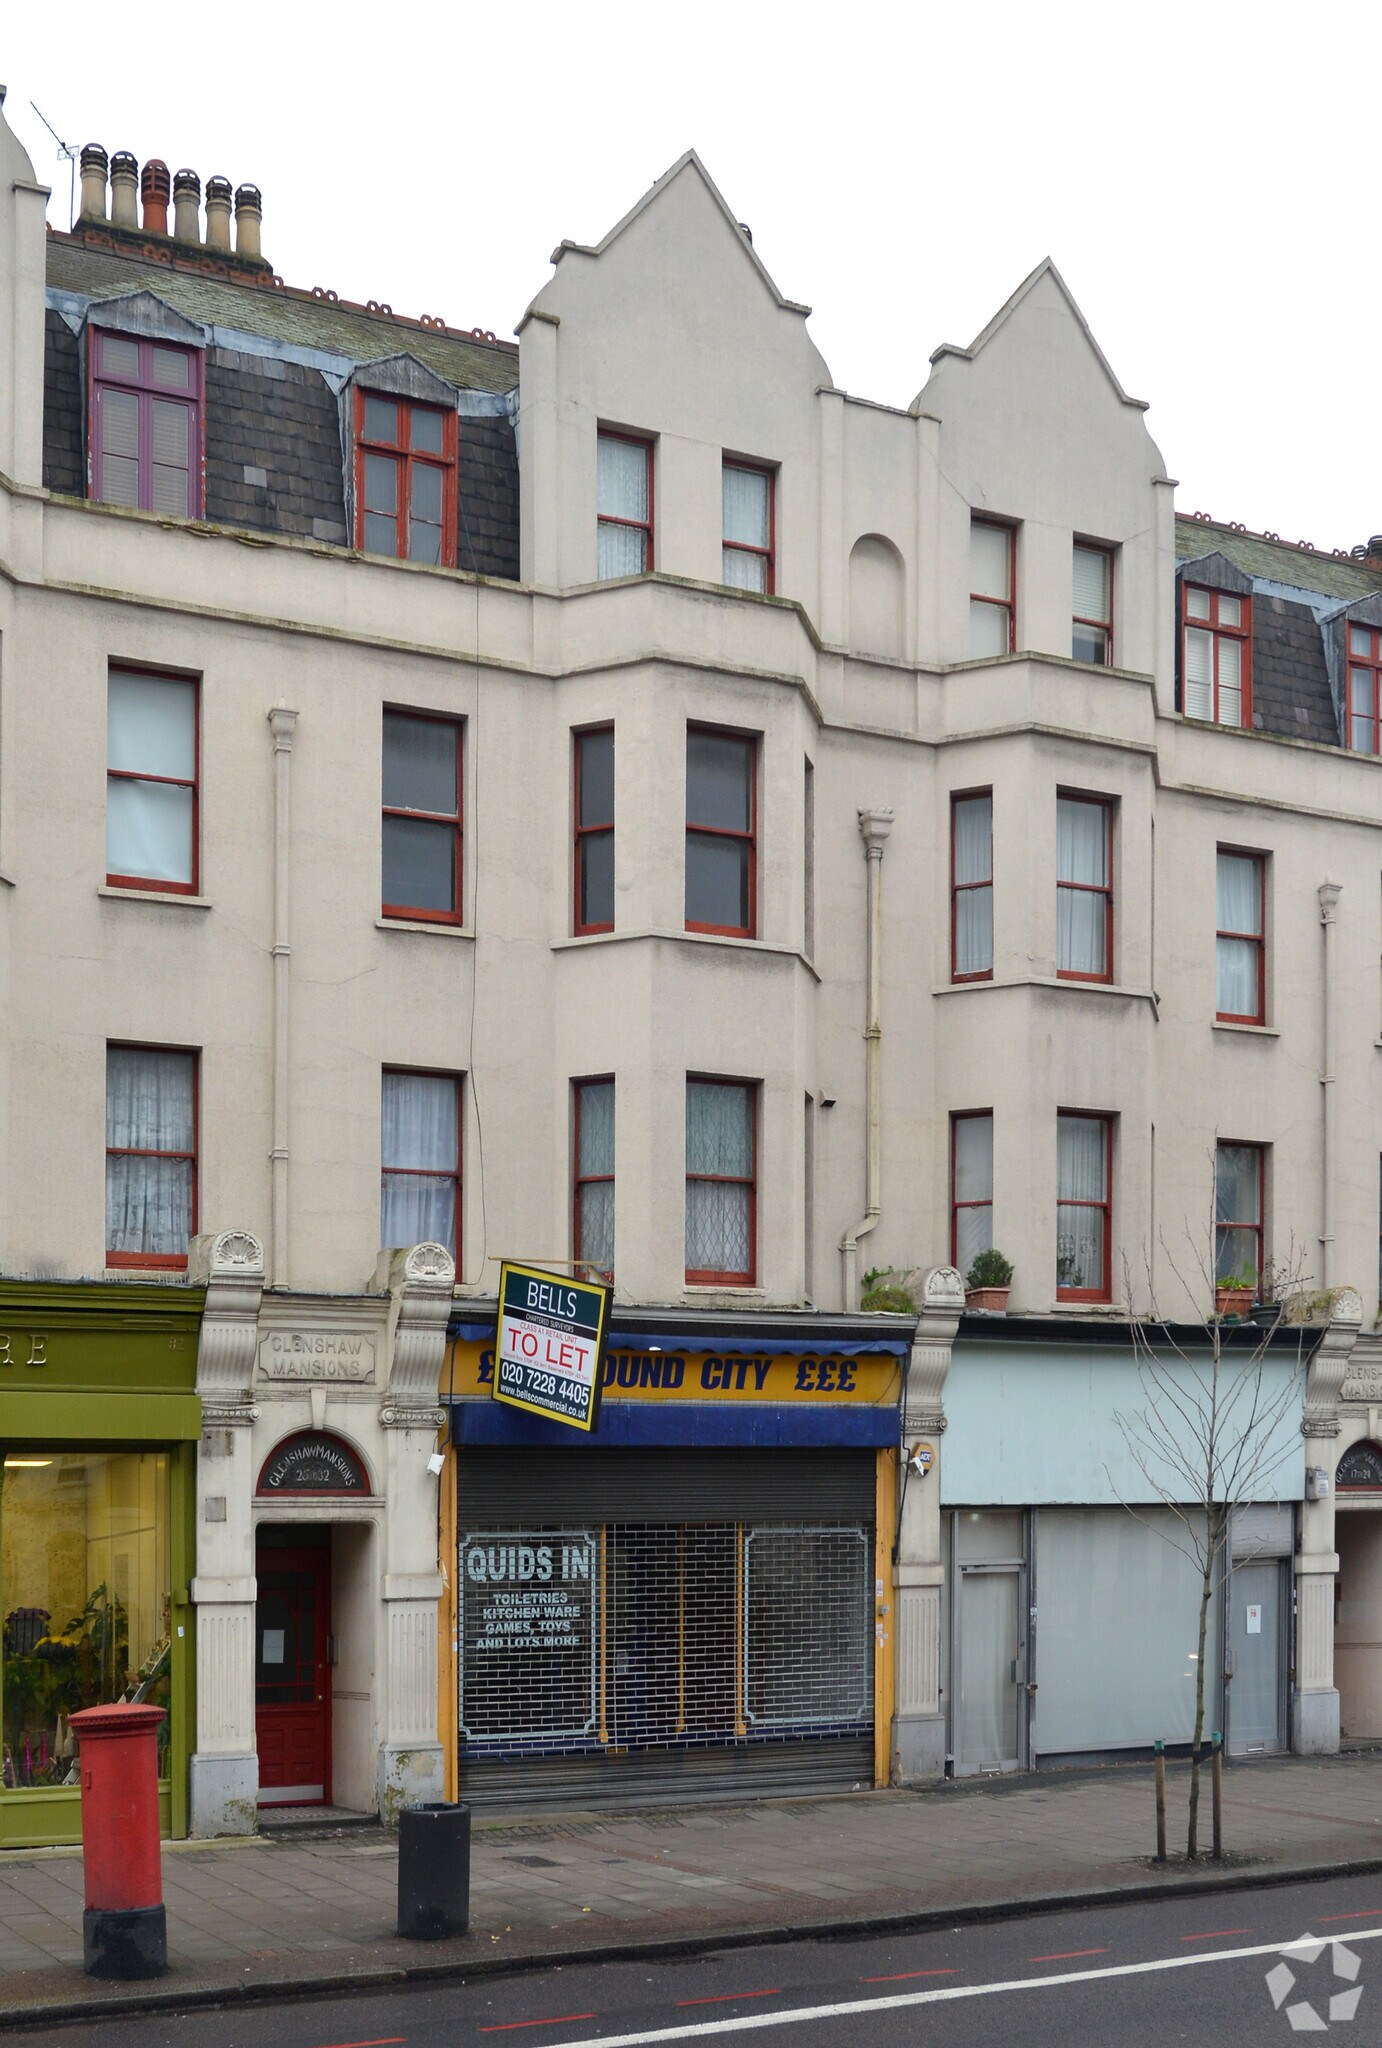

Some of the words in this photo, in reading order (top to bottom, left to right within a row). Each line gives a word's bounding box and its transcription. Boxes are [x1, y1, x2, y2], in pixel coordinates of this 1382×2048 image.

[527, 1281, 577, 1318] BELLS
[520, 1322, 537, 1333] CLASS
[546, 1329, 563, 1340] RETAIL
[564, 1333, 577, 1343] UNIT
[526, 1313, 549, 1326] CHARTERED
[550, 1320, 574, 1333] SURVEYORS
[271, 1335, 362, 1355] GLENSHAW
[508, 1328, 538, 1357] TO
[546, 1339, 589, 1371] LET
[273, 1360, 360, 1377] MANSIONS
[700, 1357, 773, 1391] CITY
[794, 1359, 858, 1393] £££
[501, 1361, 523, 1385] 020
[526, 1369, 556, 1395] 7228
[558, 1380, 590, 1406] 4405
[500, 1384, 587, 1420] www.bellscommercial.co.uk
[269, 1445, 317, 1487] GLENSHAW
[315, 1444, 356, 1487] MANSIONS
[467, 1546, 553, 1582] QUIDS
[562, 1545, 589, 1579] IN
[493, 1592, 568, 1605] TOILETRIES
[483, 1606, 540, 1620] KITCHEN
[543, 1605, 580, 1618] WARE
[485, 1621, 535, 1635] GAMES,
[538, 1620, 571, 1632] TOYS
[476, 1637, 504, 1650] AND
[508, 1636, 540, 1648] LOTS
[544, 1635, 580, 1648] MORE
